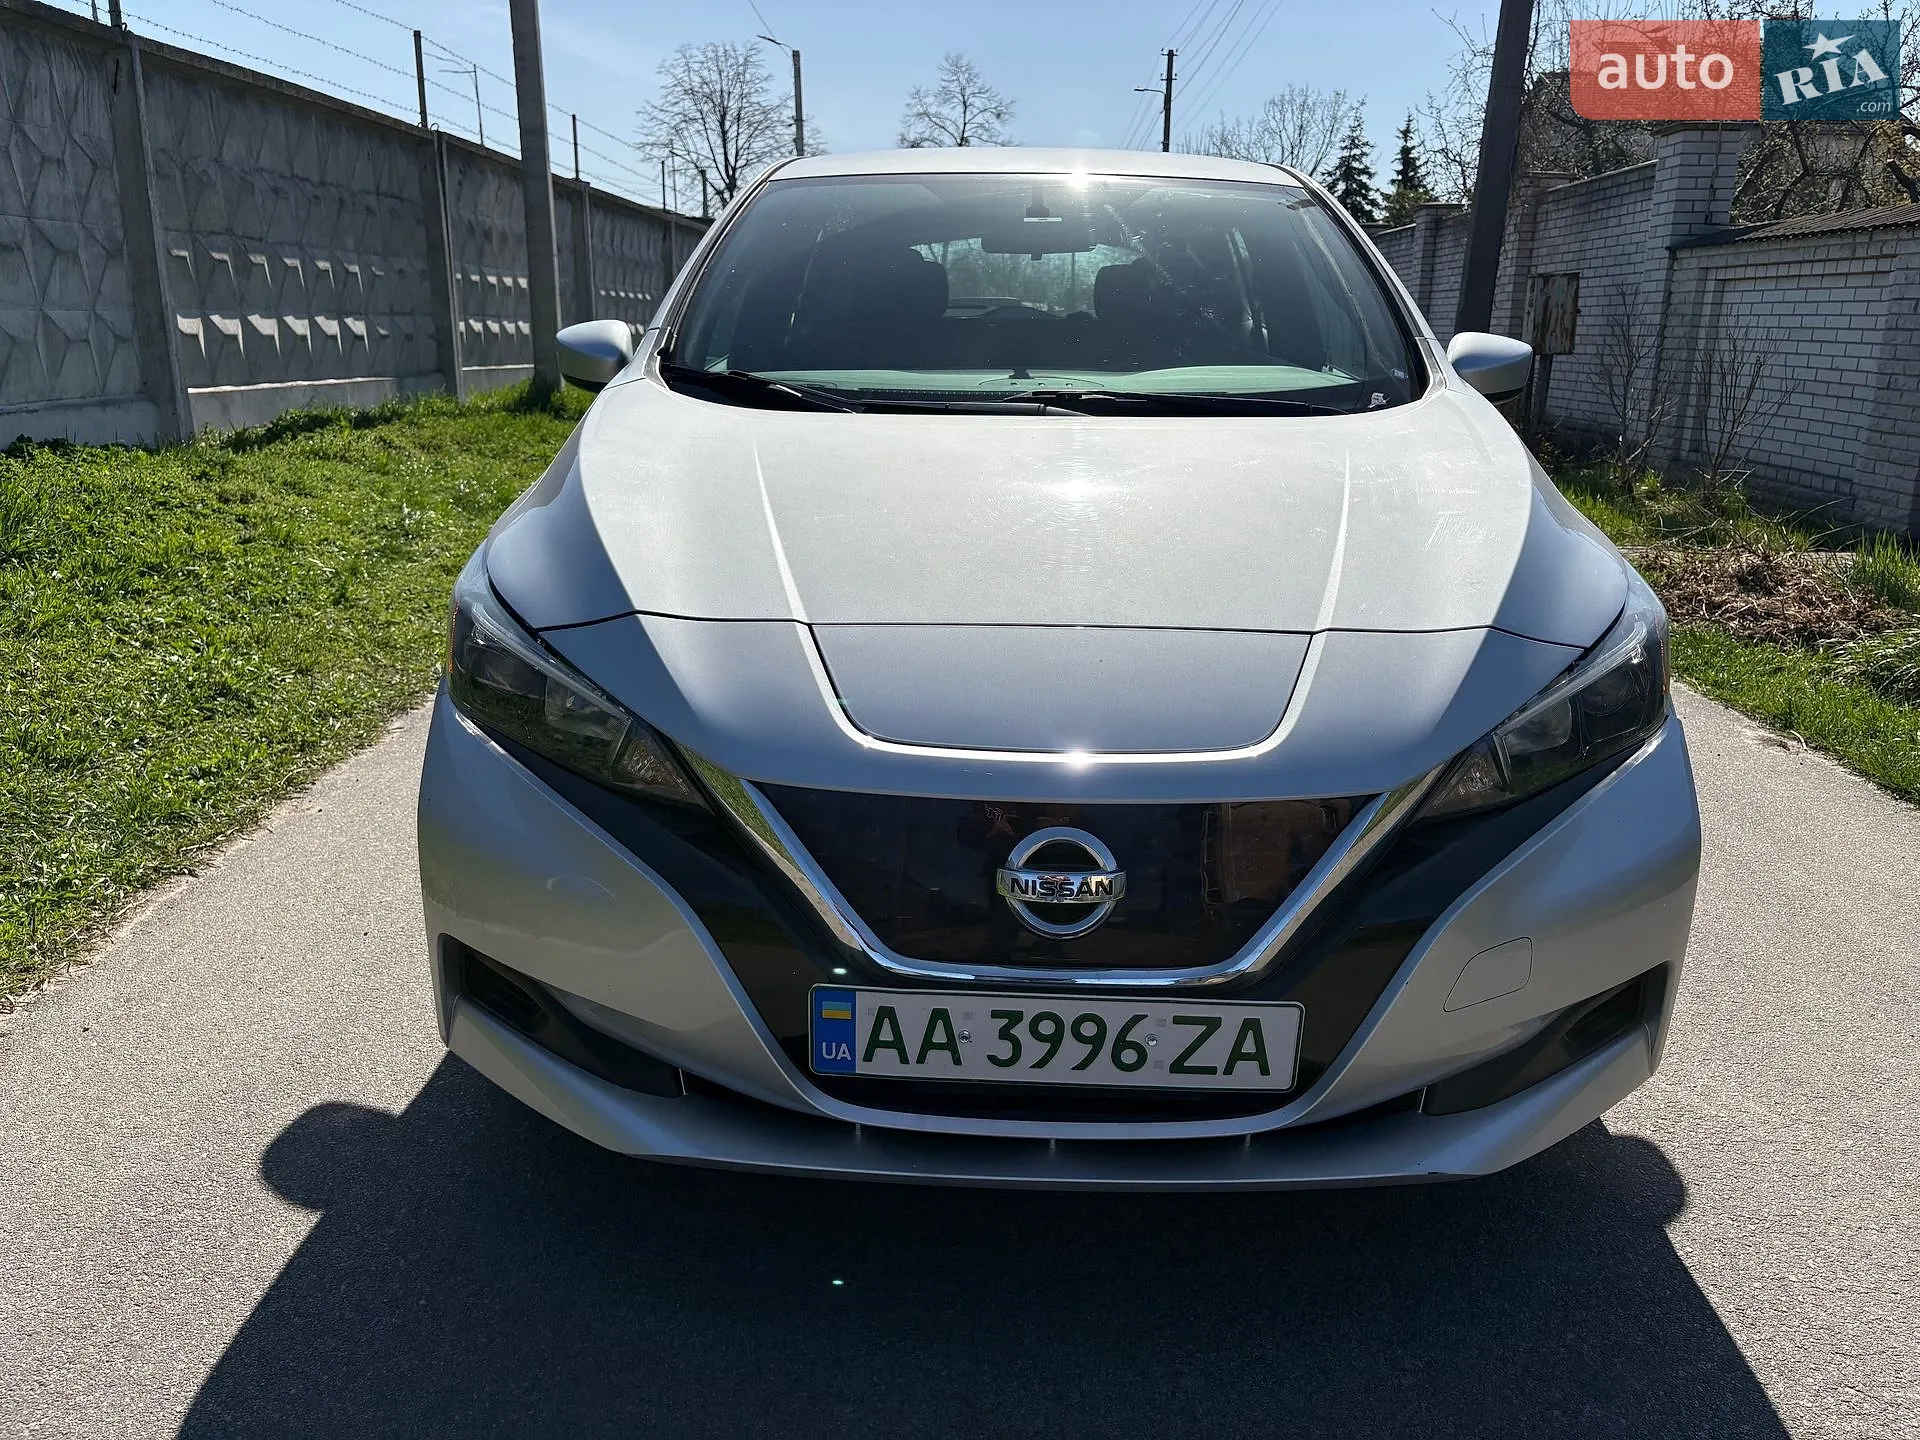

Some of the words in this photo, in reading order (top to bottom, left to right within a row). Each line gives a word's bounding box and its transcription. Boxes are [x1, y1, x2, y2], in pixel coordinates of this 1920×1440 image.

[1010, 877, 1113, 898] NISSAN
[862, 1005, 963, 1066] AA
[986, 1009, 1150, 1073] 3996
[1169, 1015, 1271, 1076] ZA
[821, 1041, 852, 1062] UA
